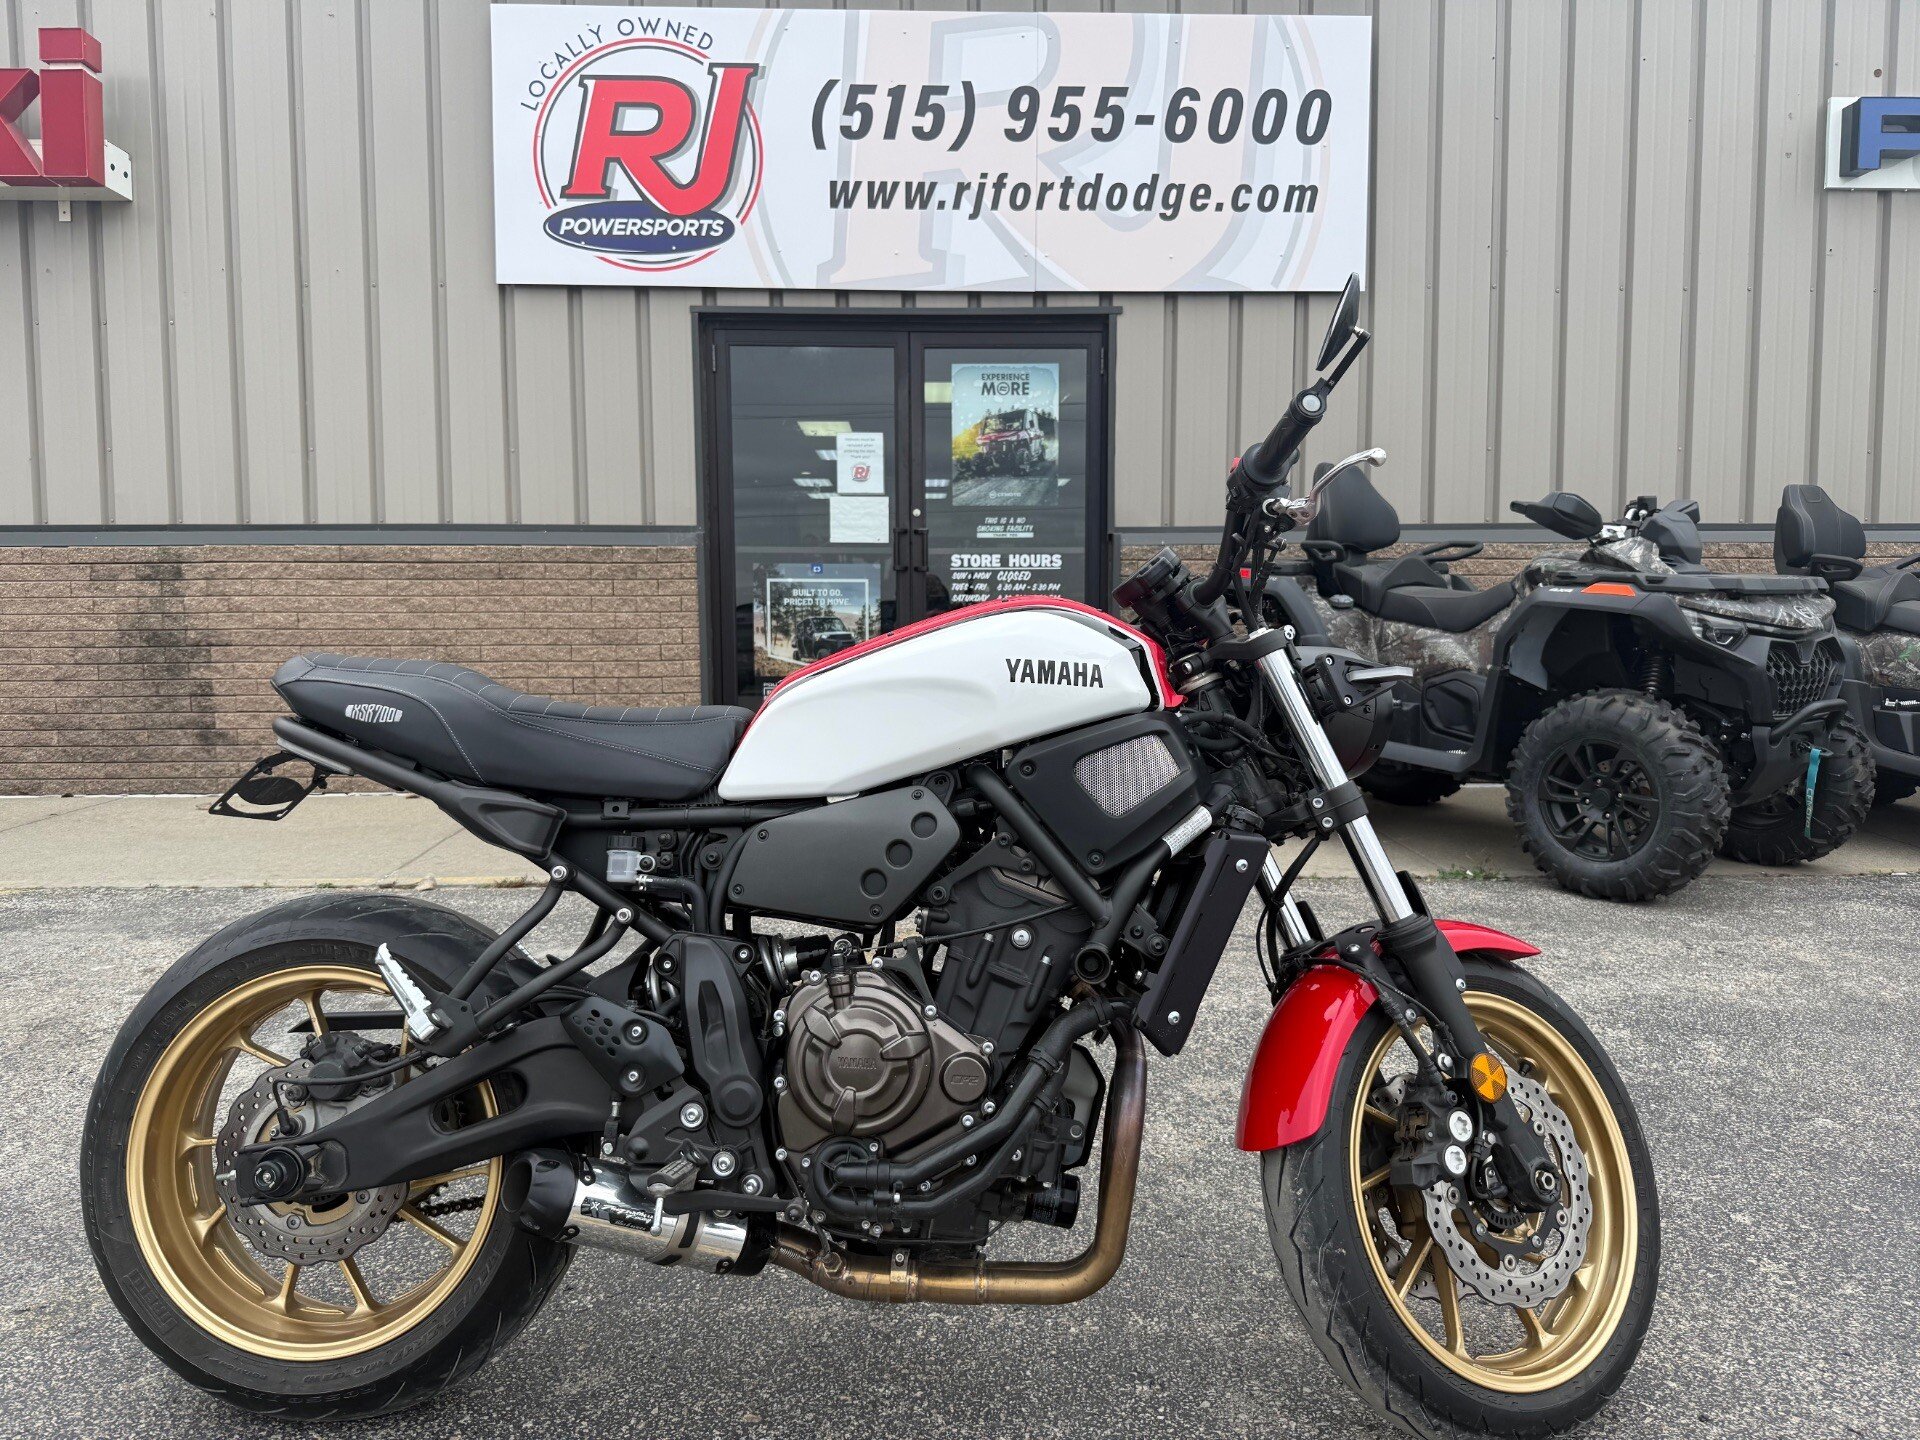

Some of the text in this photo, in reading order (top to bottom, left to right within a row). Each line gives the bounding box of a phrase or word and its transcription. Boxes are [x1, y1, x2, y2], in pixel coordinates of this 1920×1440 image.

[521, 17, 713, 111] LOCALLY OWNED
[811, 79, 1332, 152] (515) 955-6000
[560, 63, 760, 216] RJ
[829, 172, 1319, 222] www.rjfortdodge.com
[559, 217, 725, 237] POWERSPORTS
[981, 373, 1030, 381] EXPERIENCE
[950, 553, 1063, 568] STORE HOURS
[952, 571, 968, 580] SUN
[973, 571, 992, 580] MON
[996, 570, 1032, 582] CLOSED
[792, 588, 815, 597] BUILT
[817, 588, 828, 597] TO
[951, 583, 969, 591] TUES
[974, 583, 988, 591] FRI
[1012, 583, 1026, 591] AM
[1047, 583, 1061, 591] PM
[783, 598, 814, 606] PRICED
[815, 598, 825, 606] TO
[951, 594, 990, 602] SATURDAY
[1005, 658, 1104, 689] YAMAHA
[350, 703, 397, 724] XSR700
[837, 1055, 879, 1070] YAMAHA
